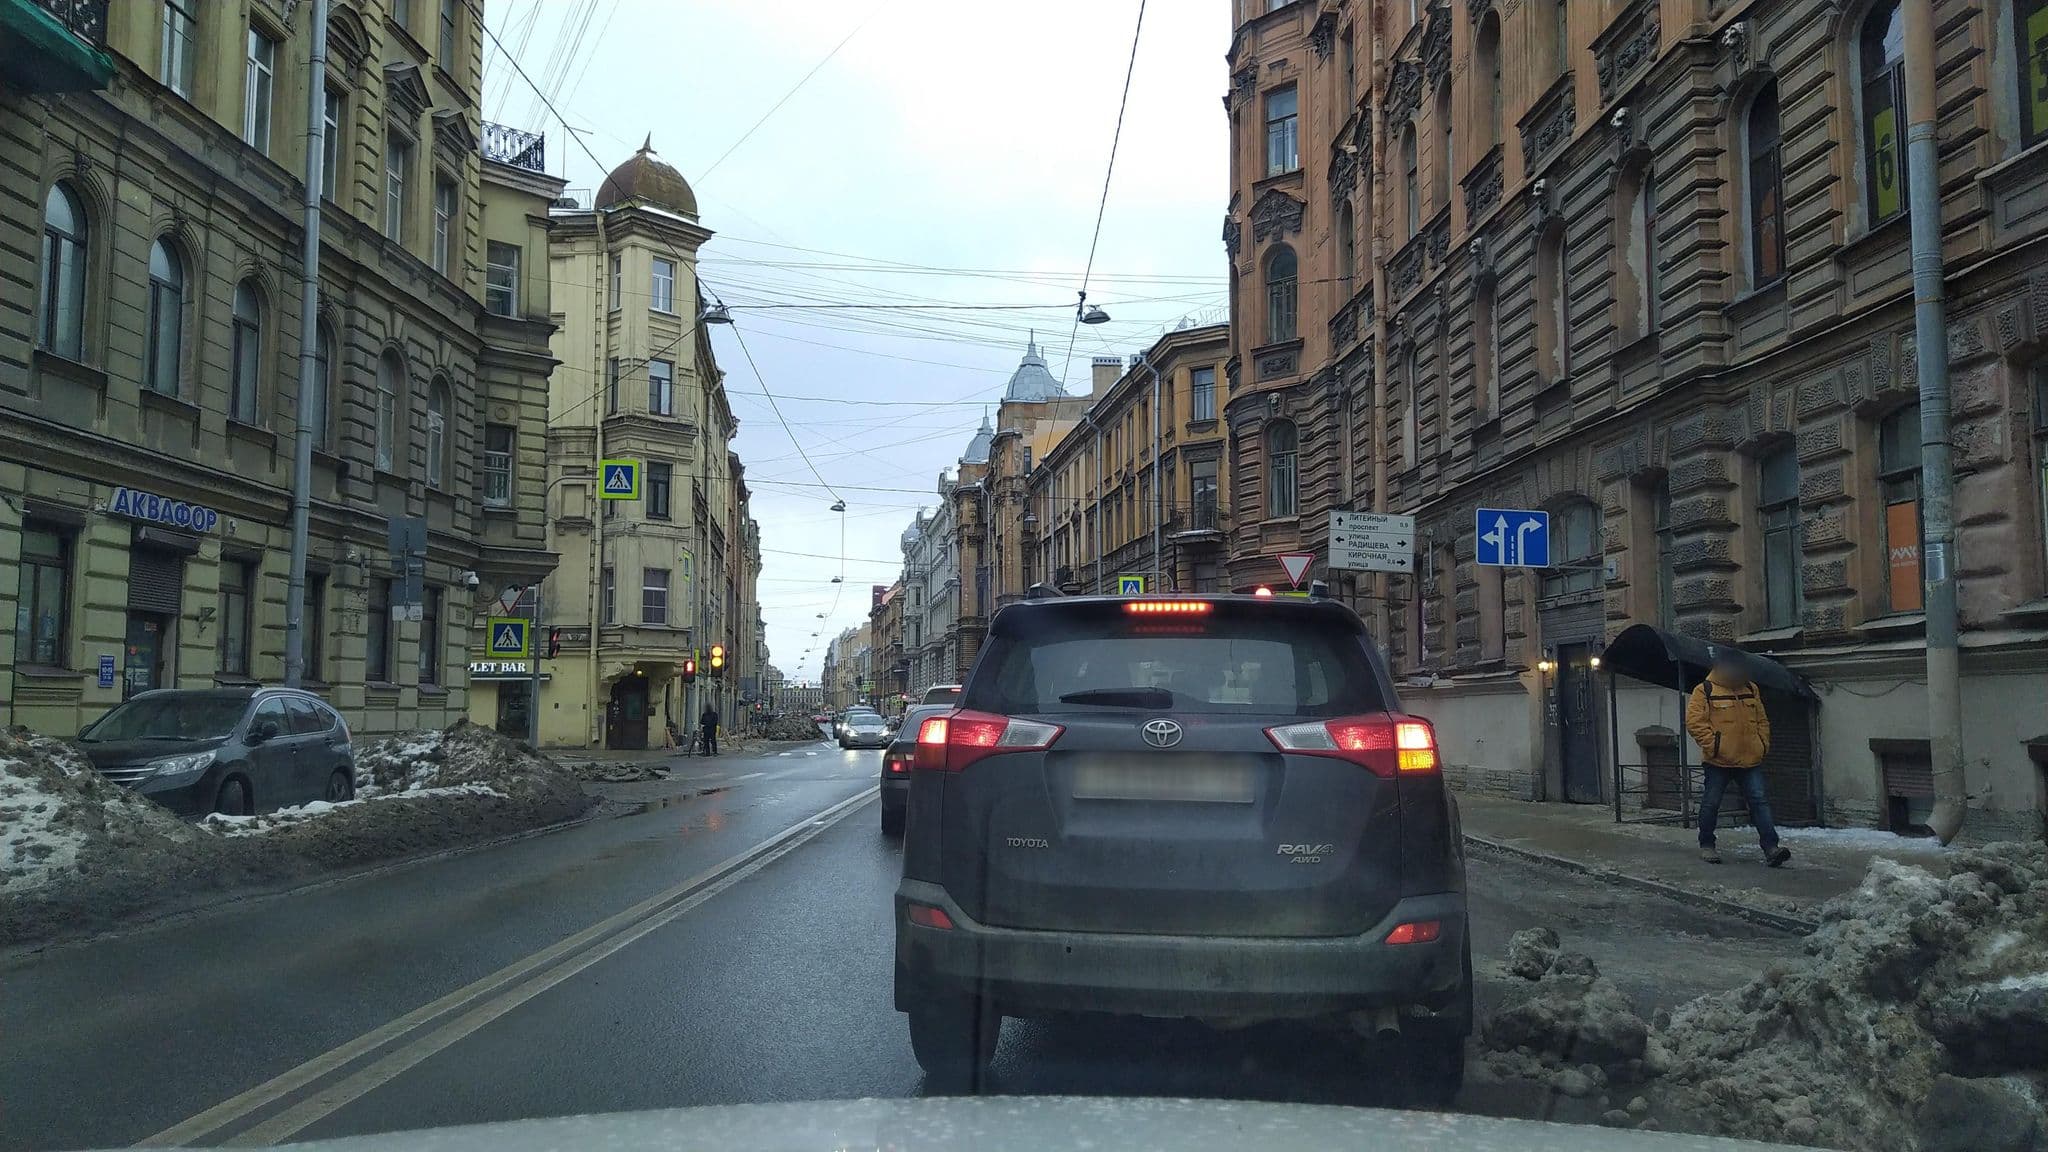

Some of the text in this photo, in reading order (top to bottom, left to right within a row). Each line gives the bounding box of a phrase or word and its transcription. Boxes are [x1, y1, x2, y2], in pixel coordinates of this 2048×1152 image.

[113, 487, 218, 532] АКВАФОР
[1348, 541, 1389, 549] РАДИЩЕВА
[1348, 552, 1387, 560] КИРОЧНАЯ
[501, 662, 526, 672] BAR
[1007, 837, 1048, 848] TOYOTA
[1277, 844, 1334, 855] RAV4
